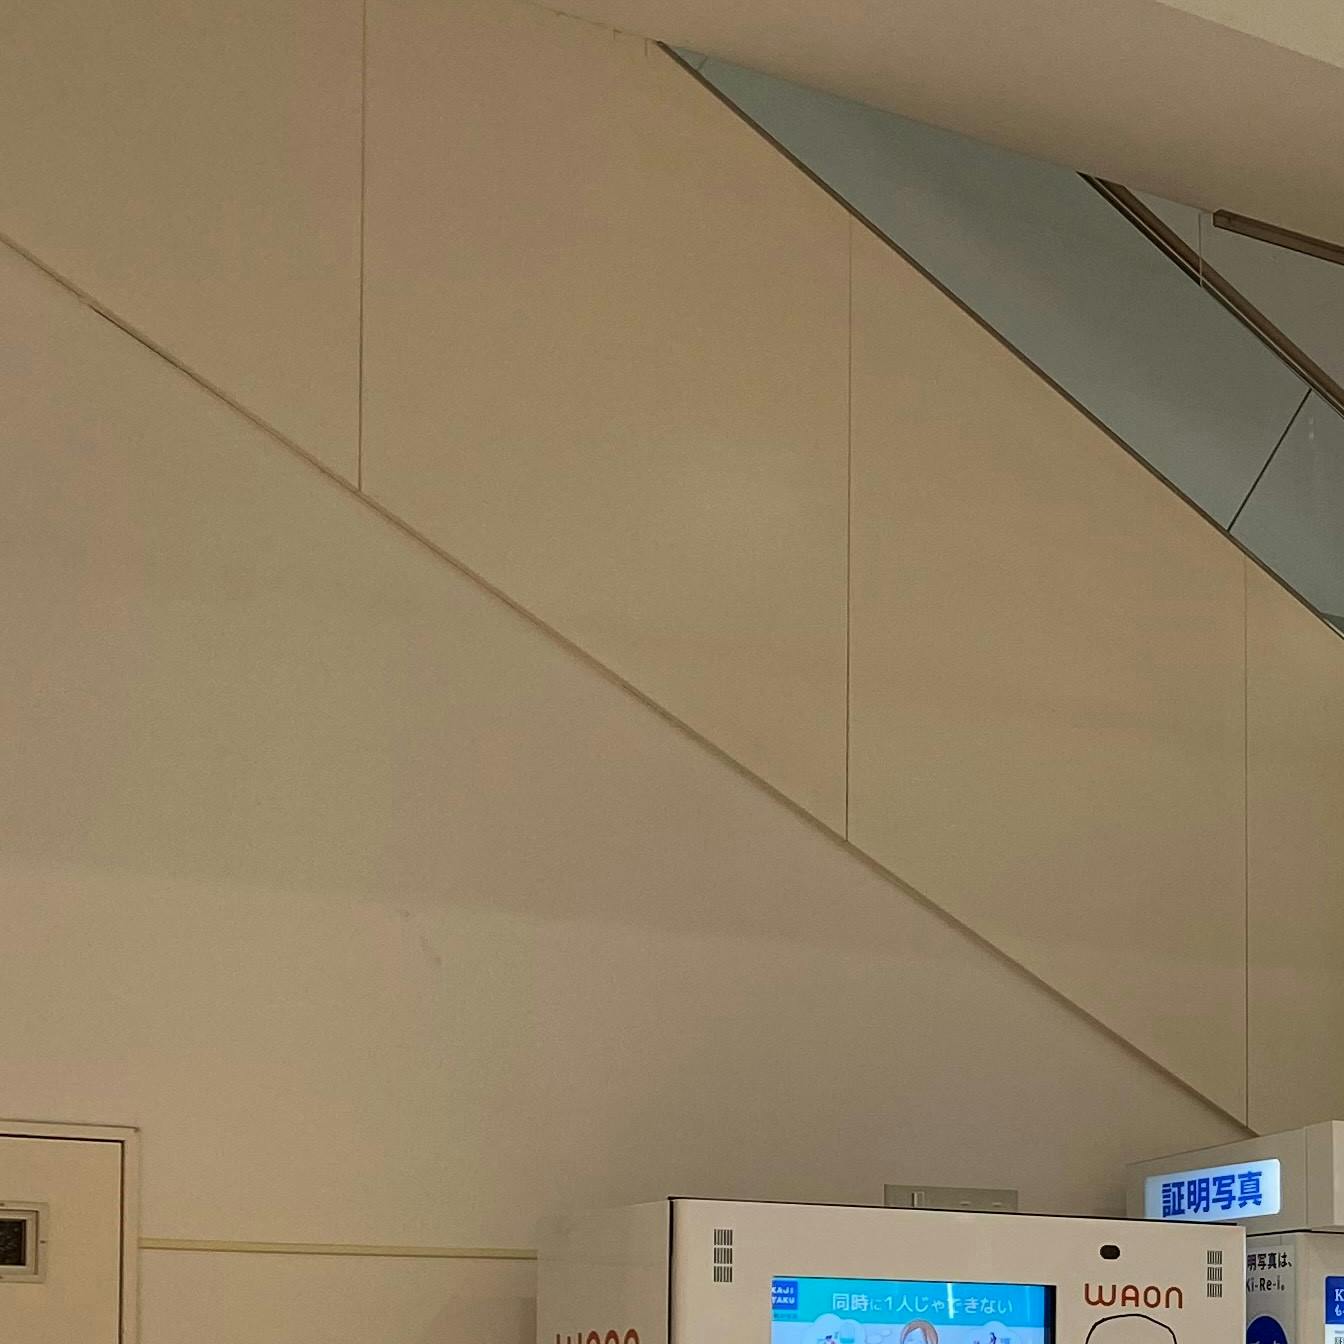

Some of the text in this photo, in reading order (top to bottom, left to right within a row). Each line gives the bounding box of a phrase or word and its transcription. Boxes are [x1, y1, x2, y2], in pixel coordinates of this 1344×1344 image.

[1162, 1171, 1262, 1218] 証明写真
[1084, 1283, 1183, 1309] WAON
